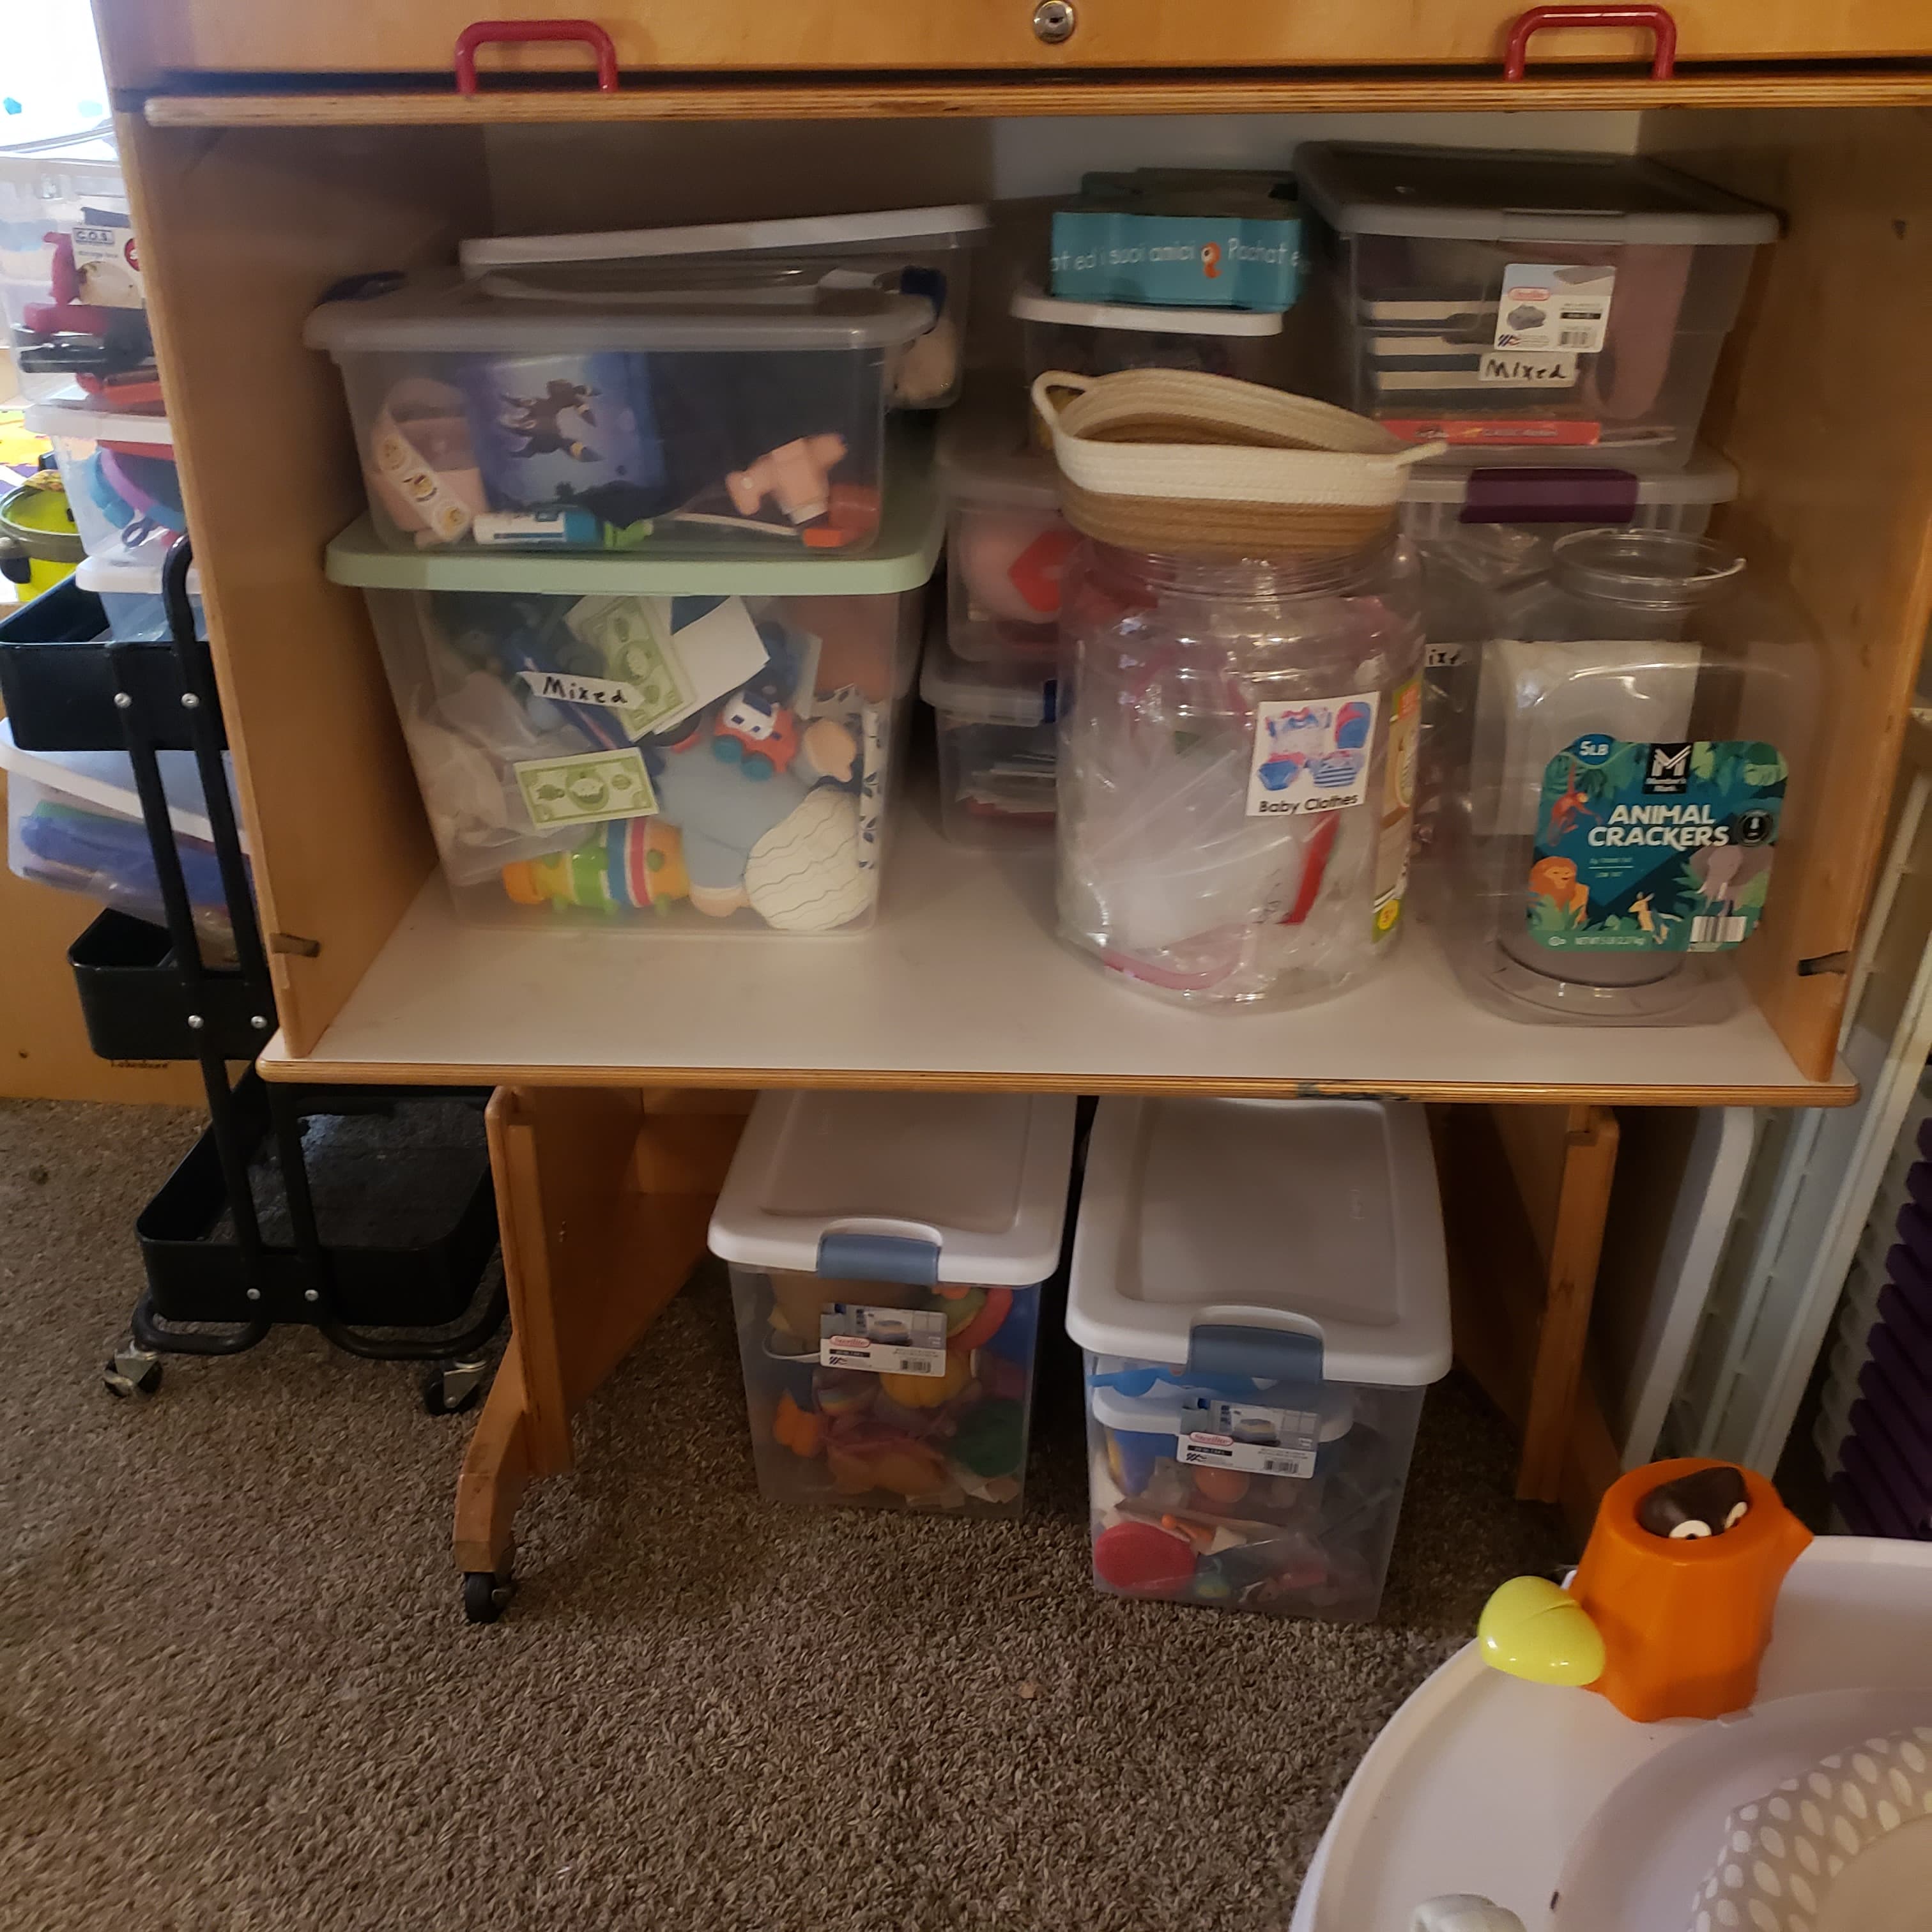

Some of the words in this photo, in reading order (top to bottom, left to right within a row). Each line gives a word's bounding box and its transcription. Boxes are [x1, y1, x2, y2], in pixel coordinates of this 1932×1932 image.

[543, 676, 627, 703] Mixed
[1259, 800, 1301, 815] Baby
[1305, 794, 1358, 810] Clothes
[1607, 804, 1716, 825] ANIMAL
[1588, 825, 1730, 852] CRACKERS
